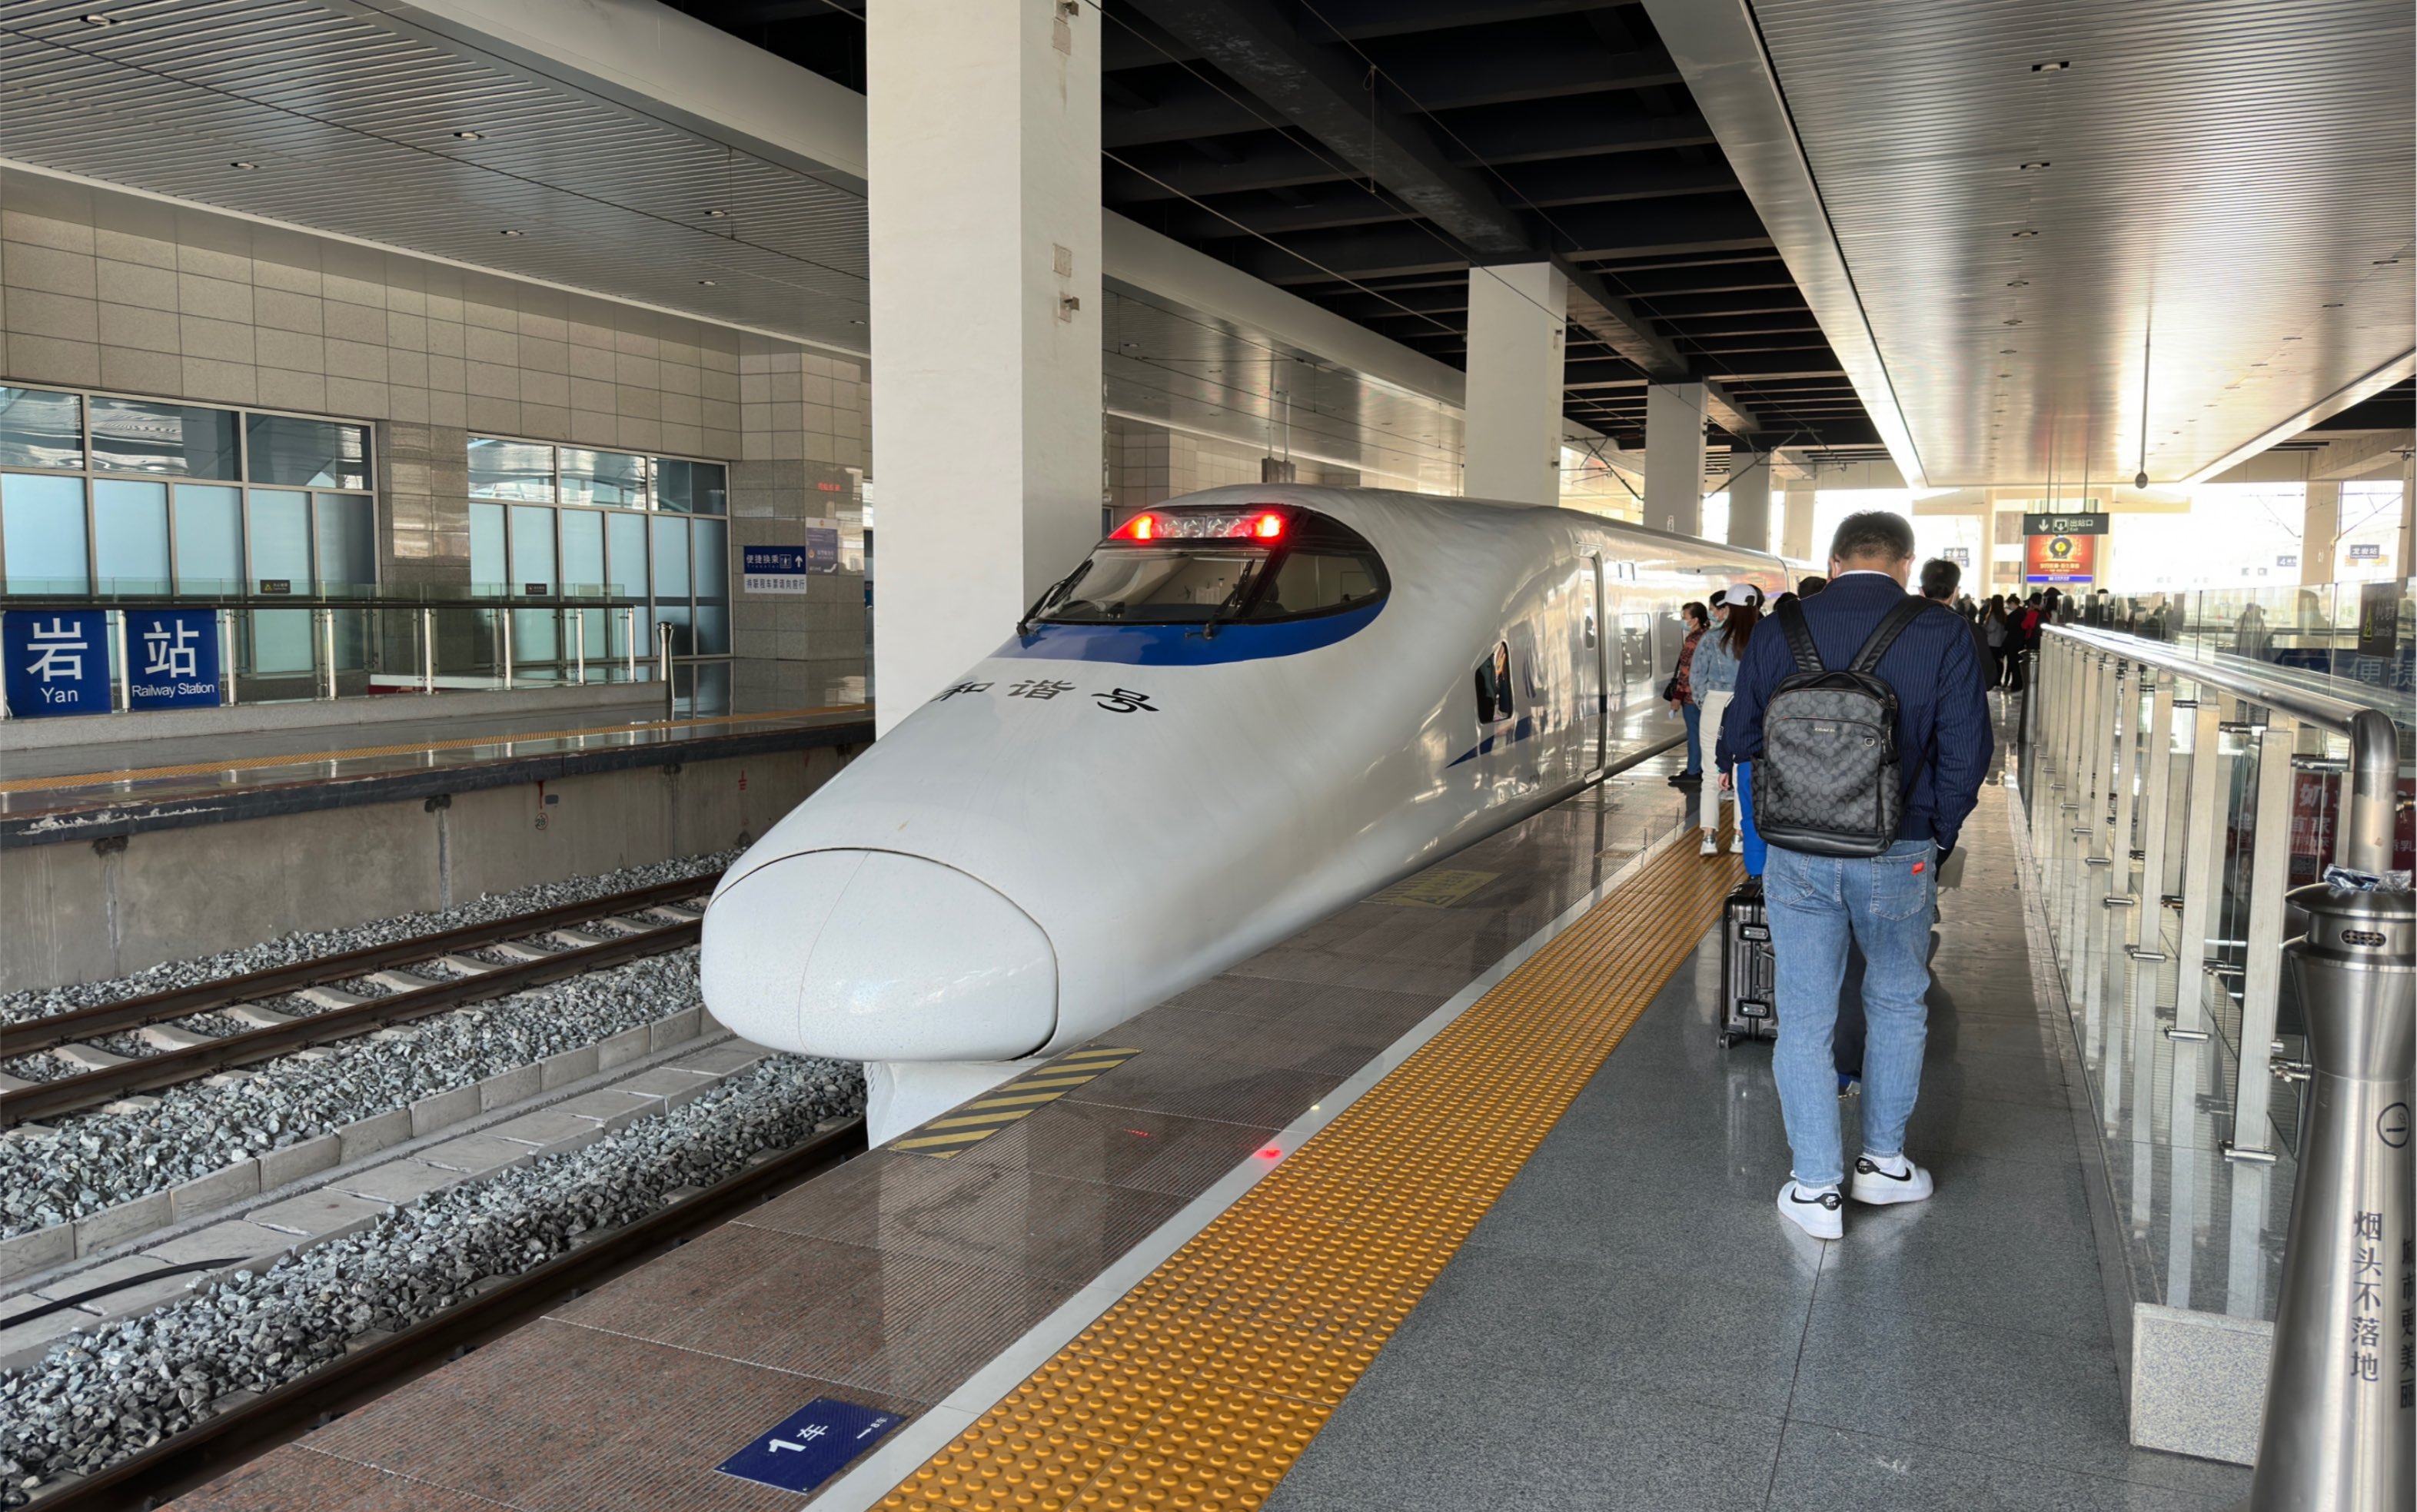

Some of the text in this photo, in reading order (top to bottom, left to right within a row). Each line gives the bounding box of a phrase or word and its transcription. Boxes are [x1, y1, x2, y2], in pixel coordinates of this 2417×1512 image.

[746, 554, 780, 563] 便捷换乘
[25, 617, 88, 682] 岩
[143, 620, 199, 678] 站
[41, 687, 78, 703] Yan
[131, 683, 214, 698] Railway Station
[929, 680, 1160, 713] 和谐号
[2350, 1211, 2382, 1381] 烟头不落地
[769, 1424, 828, 1452] 1车
